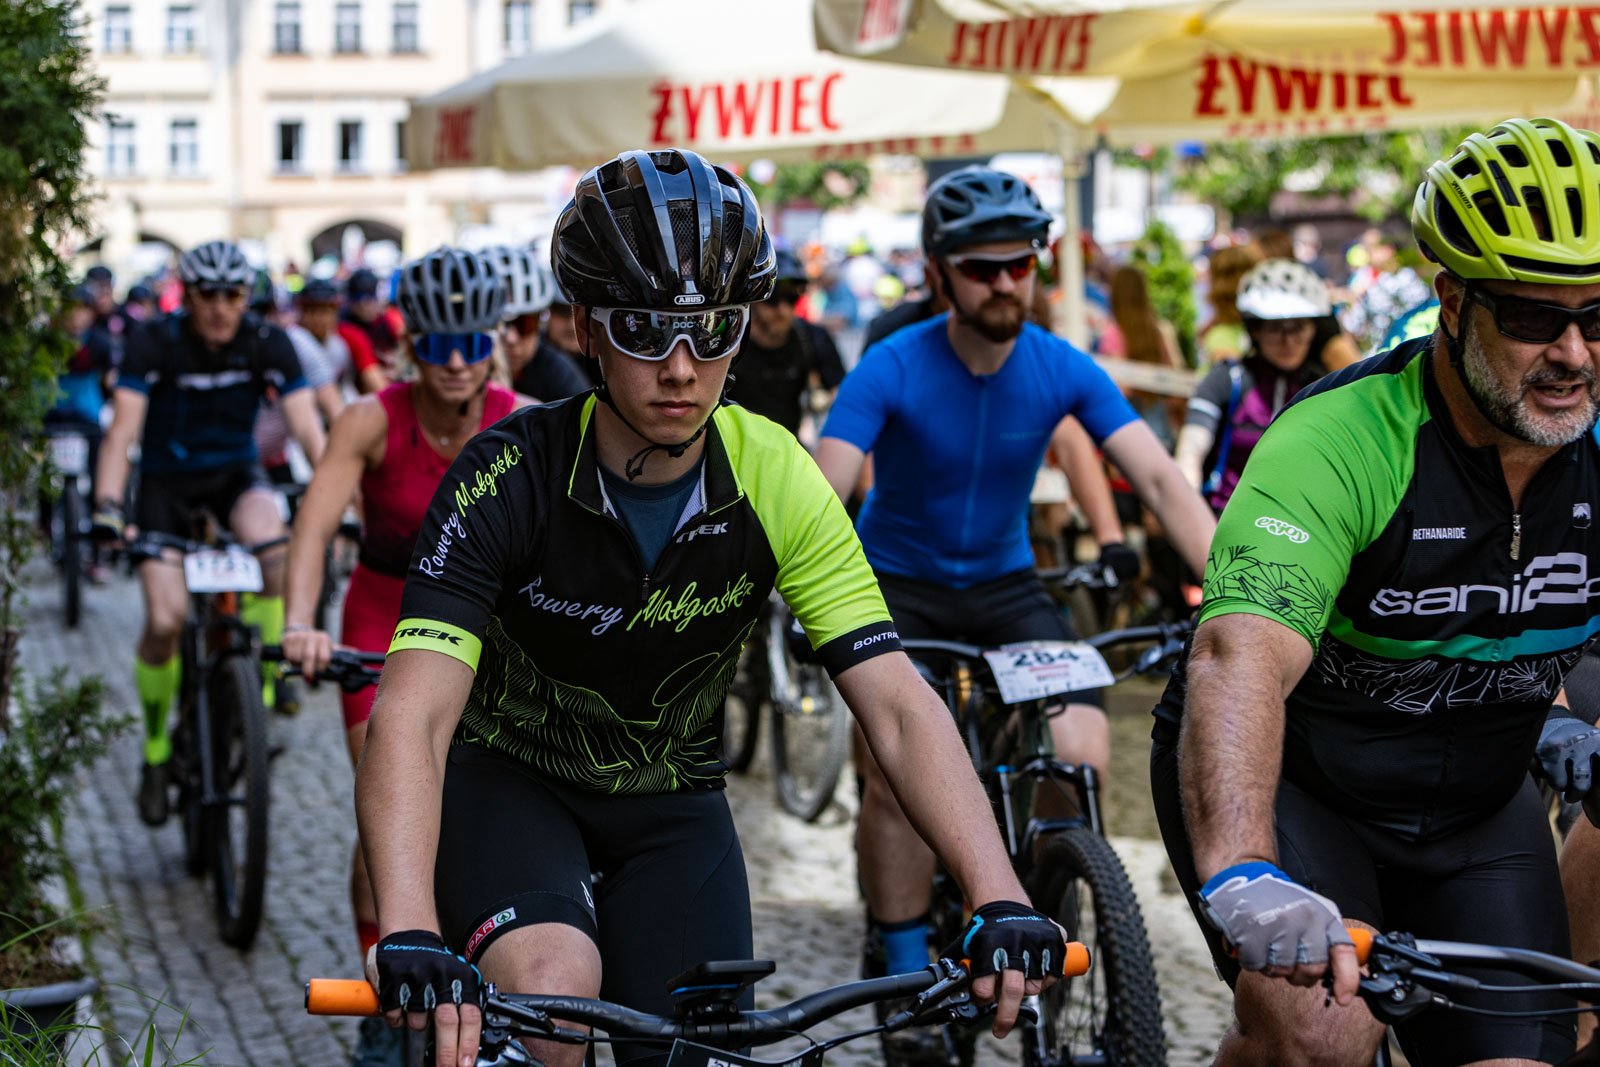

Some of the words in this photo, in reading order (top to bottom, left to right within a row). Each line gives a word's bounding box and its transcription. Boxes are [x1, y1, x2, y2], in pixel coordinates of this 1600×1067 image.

[649, 71, 842, 145] ŻYWIEC
[678, 296, 702, 304] ABUS
[419, 511, 467, 580] Rowery
